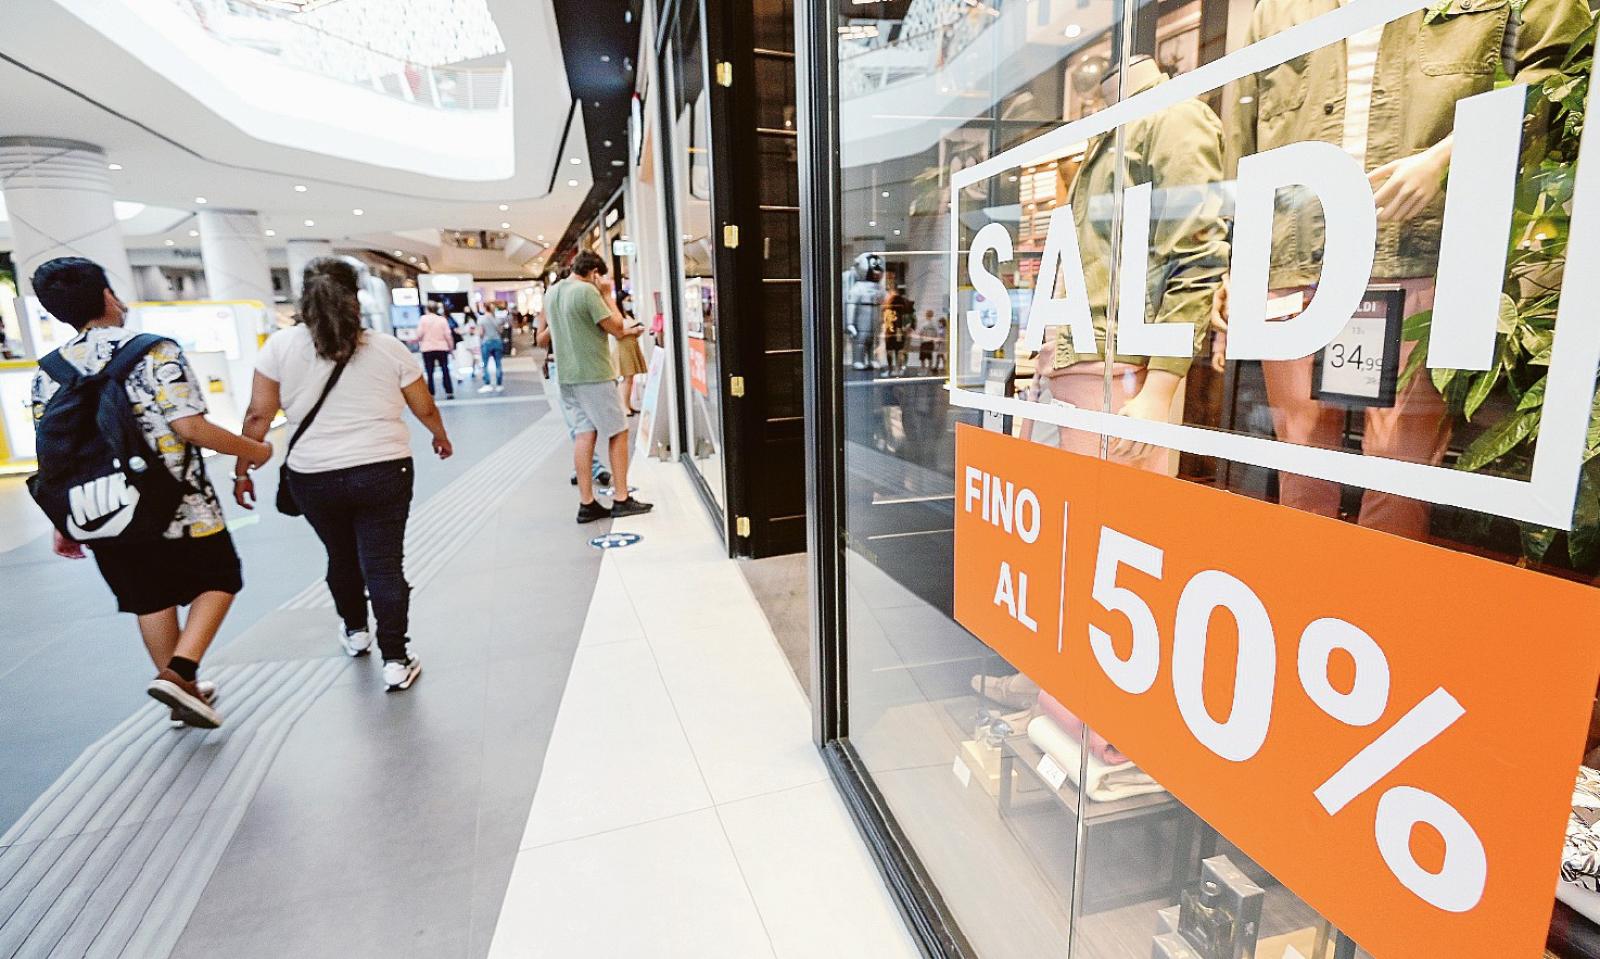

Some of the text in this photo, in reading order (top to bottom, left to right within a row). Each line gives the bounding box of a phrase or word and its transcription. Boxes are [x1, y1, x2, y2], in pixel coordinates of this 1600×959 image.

[967, 84, 1528, 371] SALDI
[965, 465, 1041, 544] FINO
[993, 561, 1038, 633] AL
[1088, 525, 1487, 912] 50%
